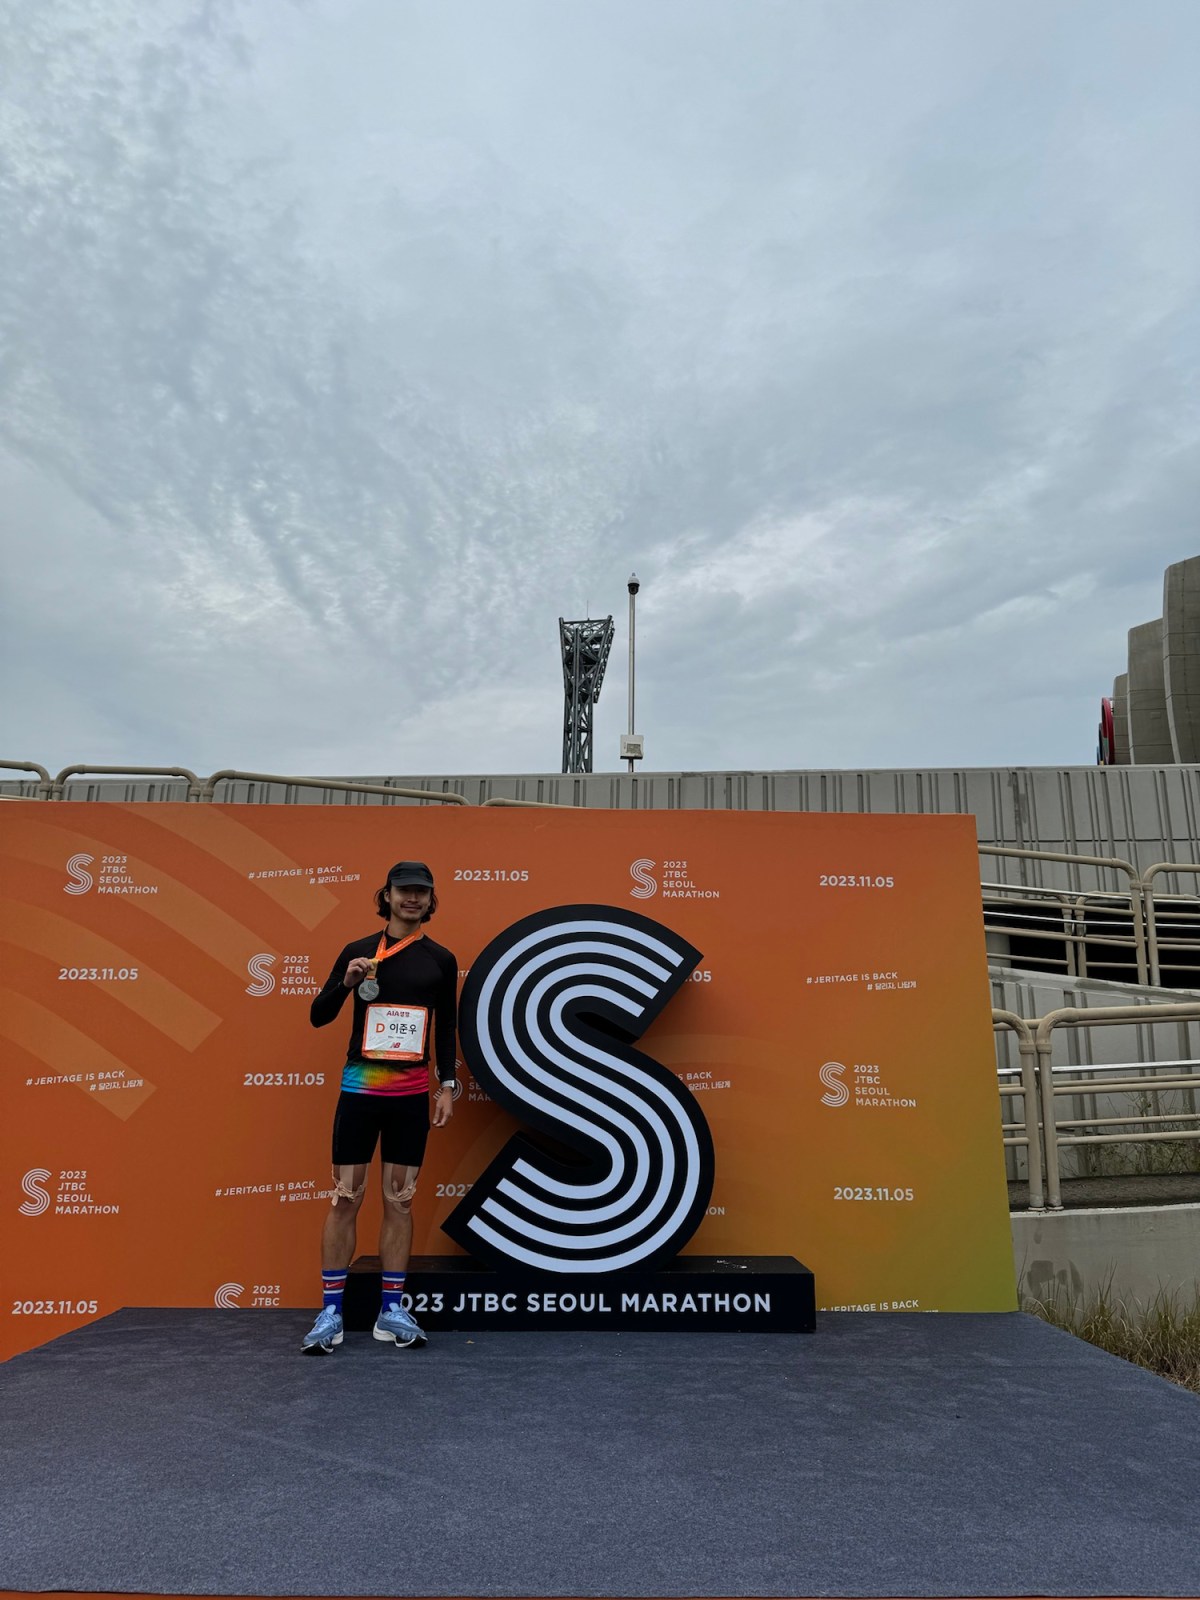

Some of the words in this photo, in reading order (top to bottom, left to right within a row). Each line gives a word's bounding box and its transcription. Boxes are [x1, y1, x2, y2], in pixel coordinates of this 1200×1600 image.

[317, 866, 342, 874] BACK
[454, 870, 528, 881] 2023.11.05
[820, 875, 894, 887] 2023.11.05
[59, 968, 138, 980] 2023.11.05
[873, 972, 897, 980] BACK
[282, 976, 316, 984] SEOUL
[376, 1023, 385, 1033] D
[389, 1023, 417, 1035] 이준우
[854, 1065, 879, 1073] 2023
[98, 1071, 124, 1079] BACK
[244, 1073, 324, 1085] 2023.11.05
[687, 1072, 712, 1080] BACK
[855, 1076, 880, 1084] JTBC
[855, 1087, 889, 1095] SEOUL
[856, 1098, 916, 1107] MARATHON
[60, 1171, 86, 1179] 2023
[58, 1182, 85, 1190] JTBC
[276, 1183, 284, 1191] IS
[288, 1181, 314, 1190] BACK
[834, 1187, 913, 1200] 2023.11.05
[57, 1194, 93, 1202] SEOUL
[56, 1206, 119, 1214] MARATHON
[253, 1286, 280, 1294] 2023
[252, 1298, 279, 1306] JTBC
[400, 1293, 444, 1313] 023
[453, 1293, 517, 1312] JTBC
[527, 1294, 611, 1312] SEOUL
[622, 1294, 770, 1312] MARATHON
[892, 1300, 918, 1309] BACK
[12, 1301, 97, 1314] 2023.11.05
